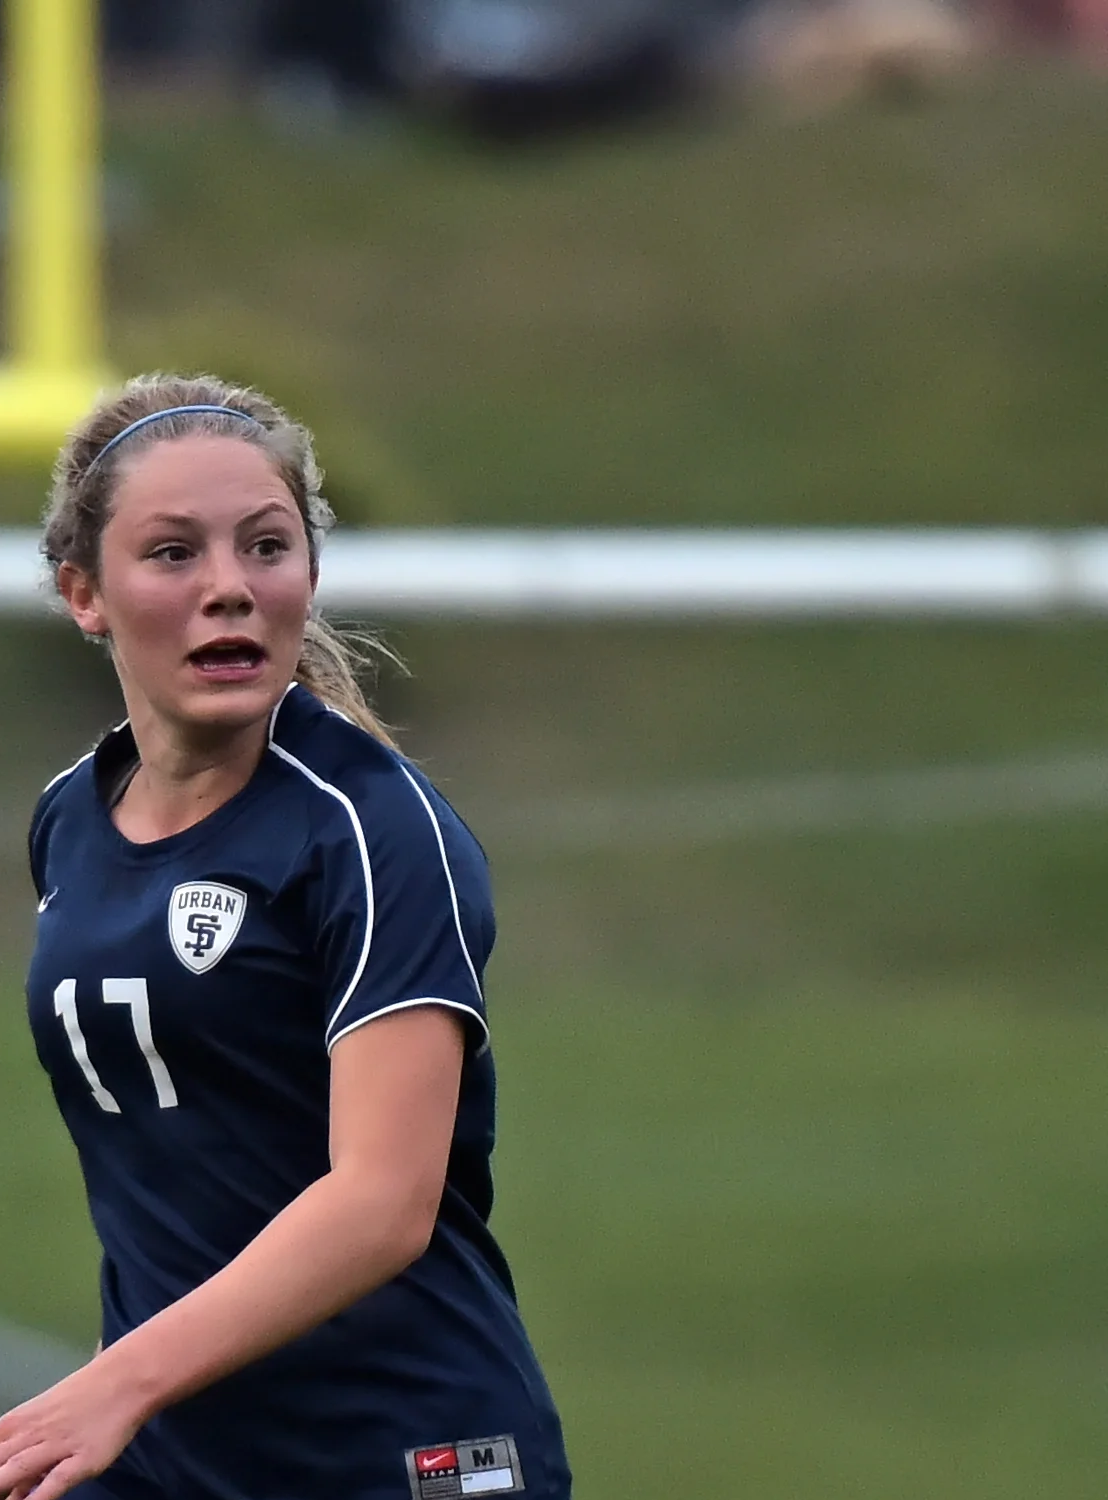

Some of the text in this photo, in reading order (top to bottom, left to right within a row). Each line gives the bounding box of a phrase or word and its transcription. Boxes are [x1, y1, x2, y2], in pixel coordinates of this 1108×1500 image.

[178, 891, 237, 915] URBAN
[53, 978, 179, 1114] 17
[472, 1447, 495, 1467] M
[423, 1468, 456, 1478] TEAM
